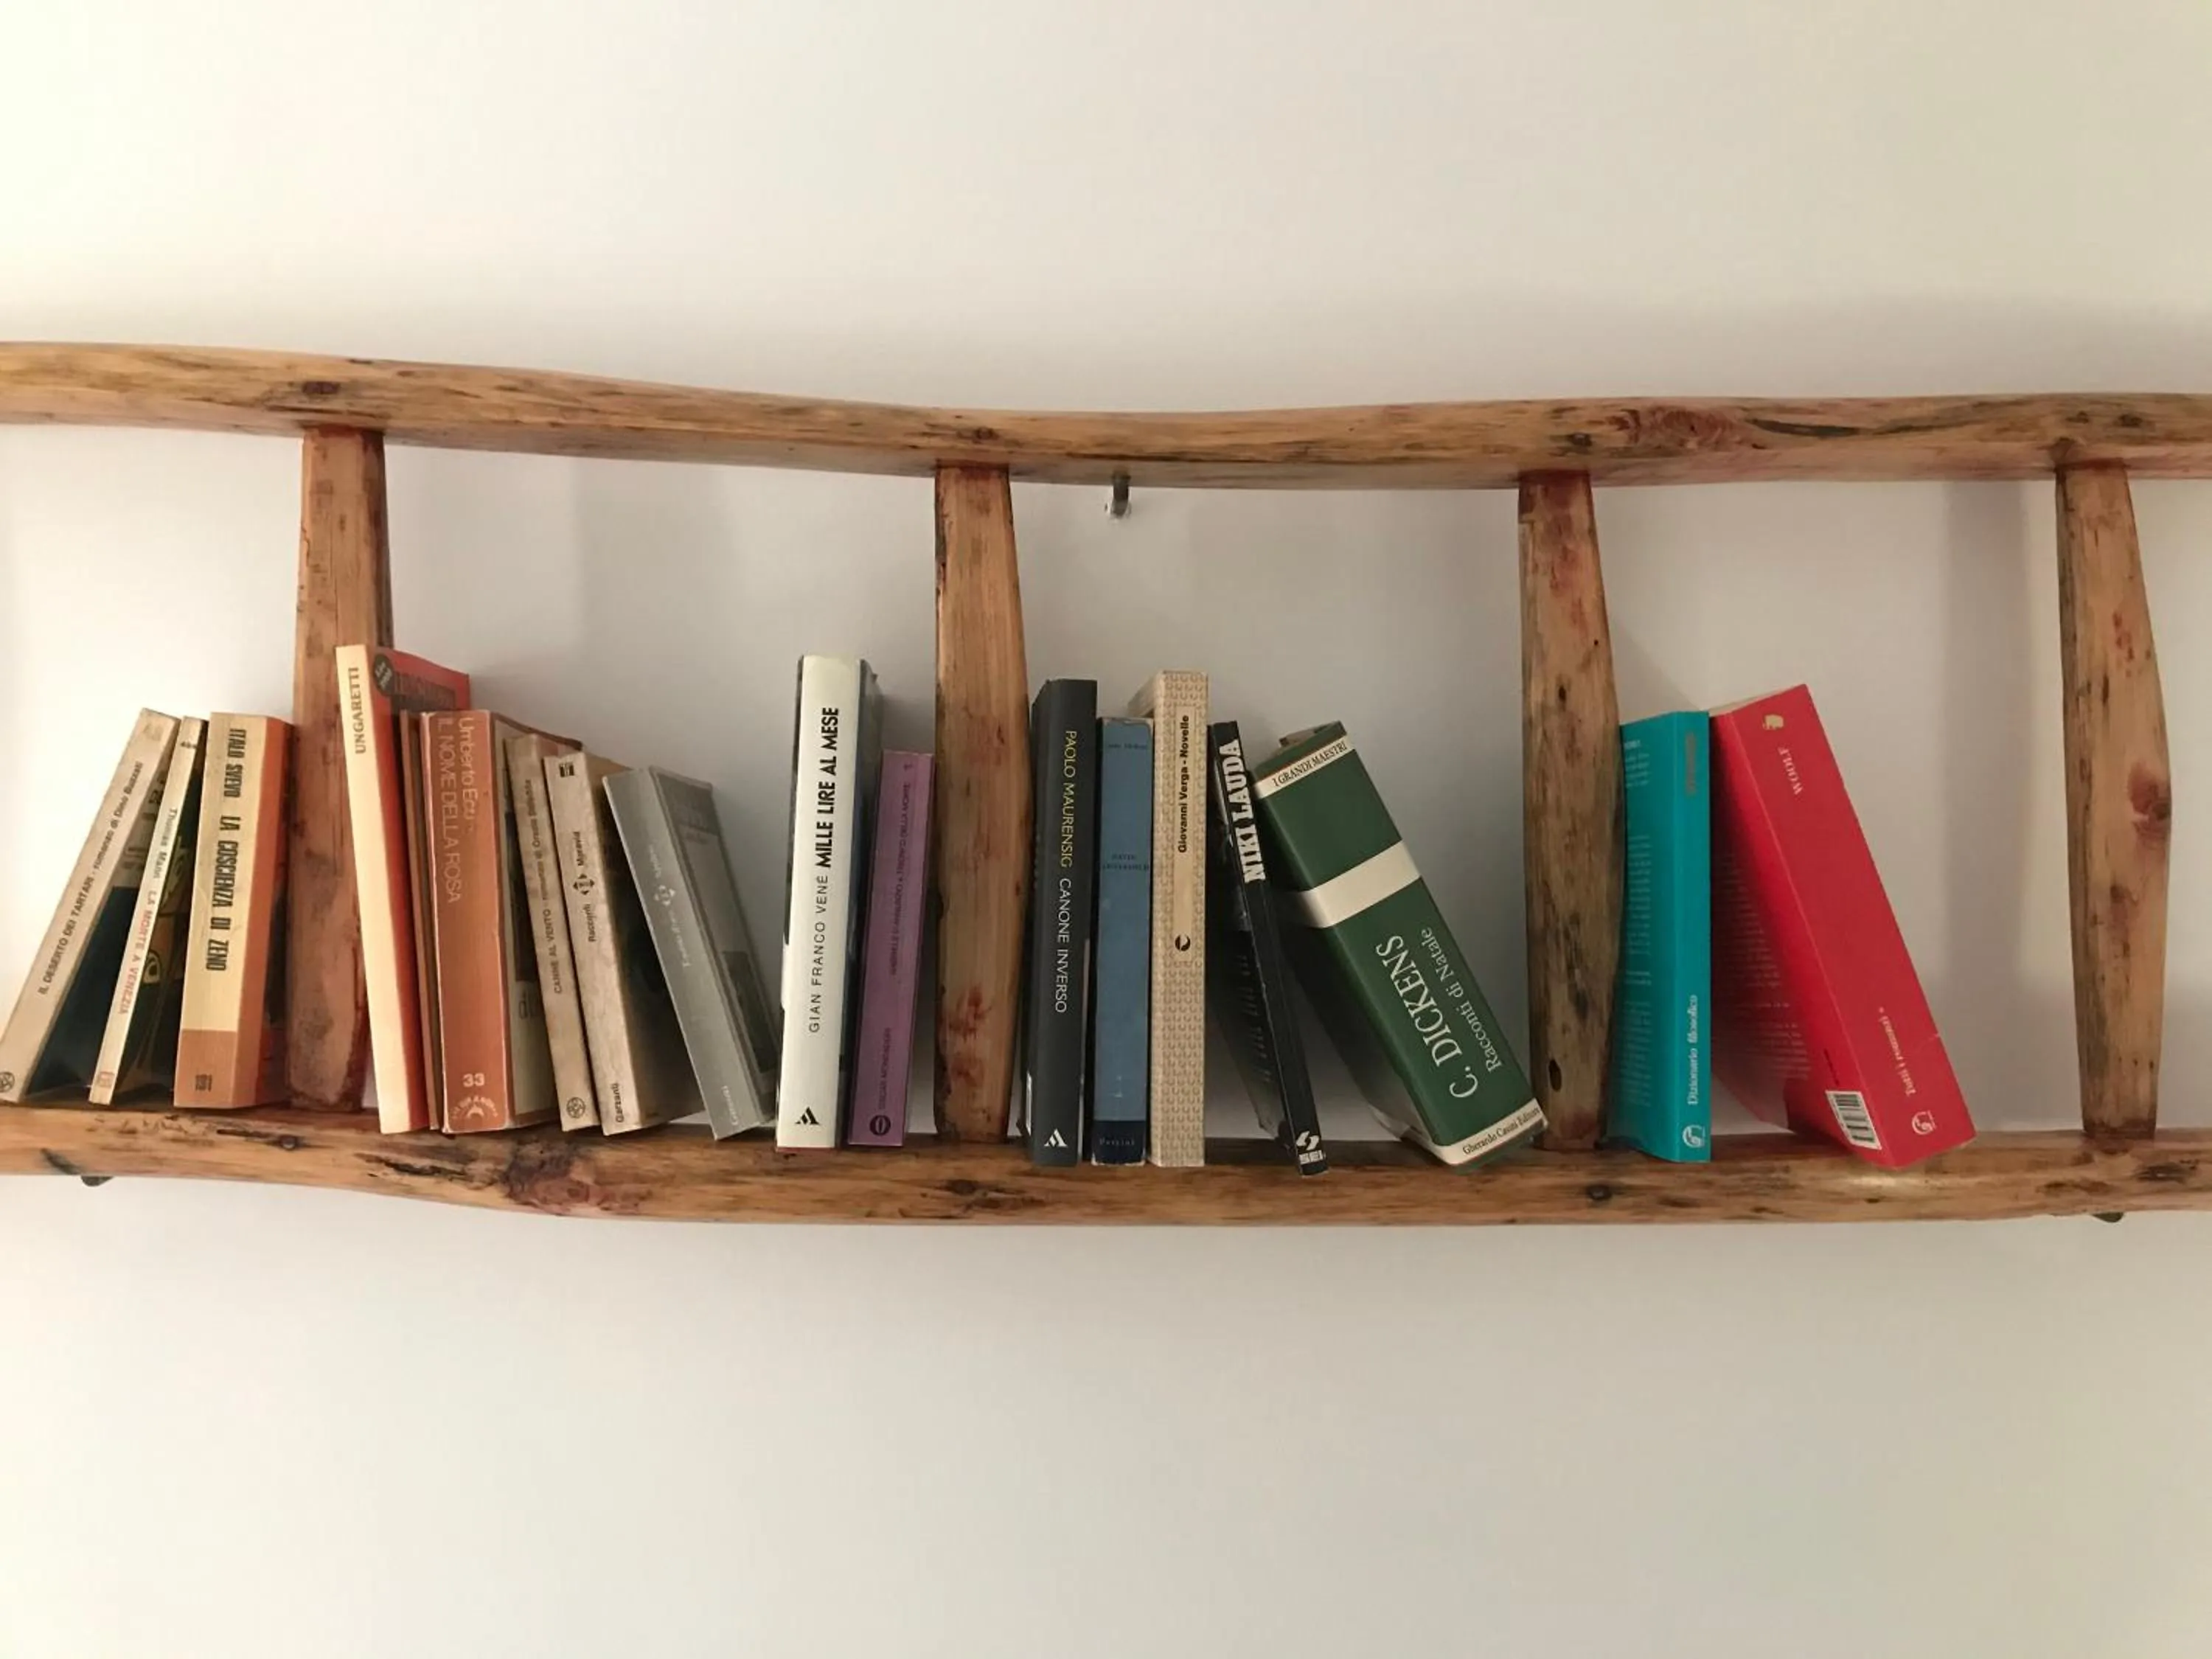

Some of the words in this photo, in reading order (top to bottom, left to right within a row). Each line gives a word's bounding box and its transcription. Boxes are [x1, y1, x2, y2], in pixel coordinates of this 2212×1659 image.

[348, 666, 366, 754] UNGARETTI
[437, 717, 454, 731] IL
[821, 706, 840, 751] MESE
[226, 728, 247, 759] ITALO
[458, 717, 476, 785] Umberto
[1063, 730, 1077, 778] PAOLO
[1180, 714, 1190, 759] Novelle
[223, 763, 243, 798] SVEVO
[439, 735, 456, 789] NOME
[820, 756, 838, 776] AL
[1179, 768, 1190, 801] Verga
[1219, 739, 1253, 822] LAUDA
[1272, 777, 1279, 787] I
[1278, 759, 1312, 784] GRANDI
[1311, 740, 1348, 768] MAESTRI
[1778, 746, 1804, 796] WOOLF
[114, 795, 129, 818] Dino
[441, 791, 459, 849] DELLA
[817, 781, 835, 815] LIRE
[219, 815, 241, 831] LA
[815, 821, 834, 869] MILLE
[1060, 782, 1077, 869] MAURENSIG
[1178, 801, 1189, 853] Giovanni
[153, 851, 167, 879] Mann
[212, 840, 239, 908] COSCIENZA
[1235, 824, 1266, 883] NIKI
[71, 876, 94, 919] TARTARI
[147, 891, 157, 905] LA
[445, 852, 463, 903] ROSA
[62, 919, 77, 937] DEI
[135, 909, 153, 951] MORTE
[210, 917, 231, 931] DI
[543, 908, 557, 942] VENTO
[1058, 877, 1071, 943] CANONE
[43, 936, 69, 983] DESERTO
[206, 939, 229, 972] ZENO
[811, 921, 827, 987] FRANCO
[1421, 926, 1454, 982] Natale
[38, 983, 49, 995] IL
[119, 966, 139, 1015] VENEZIA
[1055, 948, 1069, 1013] INVERSO
[1375, 935, 1463, 1067] DICKENS
[1445, 981, 1464, 999] di
[808, 992, 822, 1033] GIAN
[1455, 1000, 1503, 1073] Racconti
[462, 1072, 485, 1088] 33
[1449, 1065, 1478, 1098] C.
[1687, 1048, 1699, 1105] Dizionario
